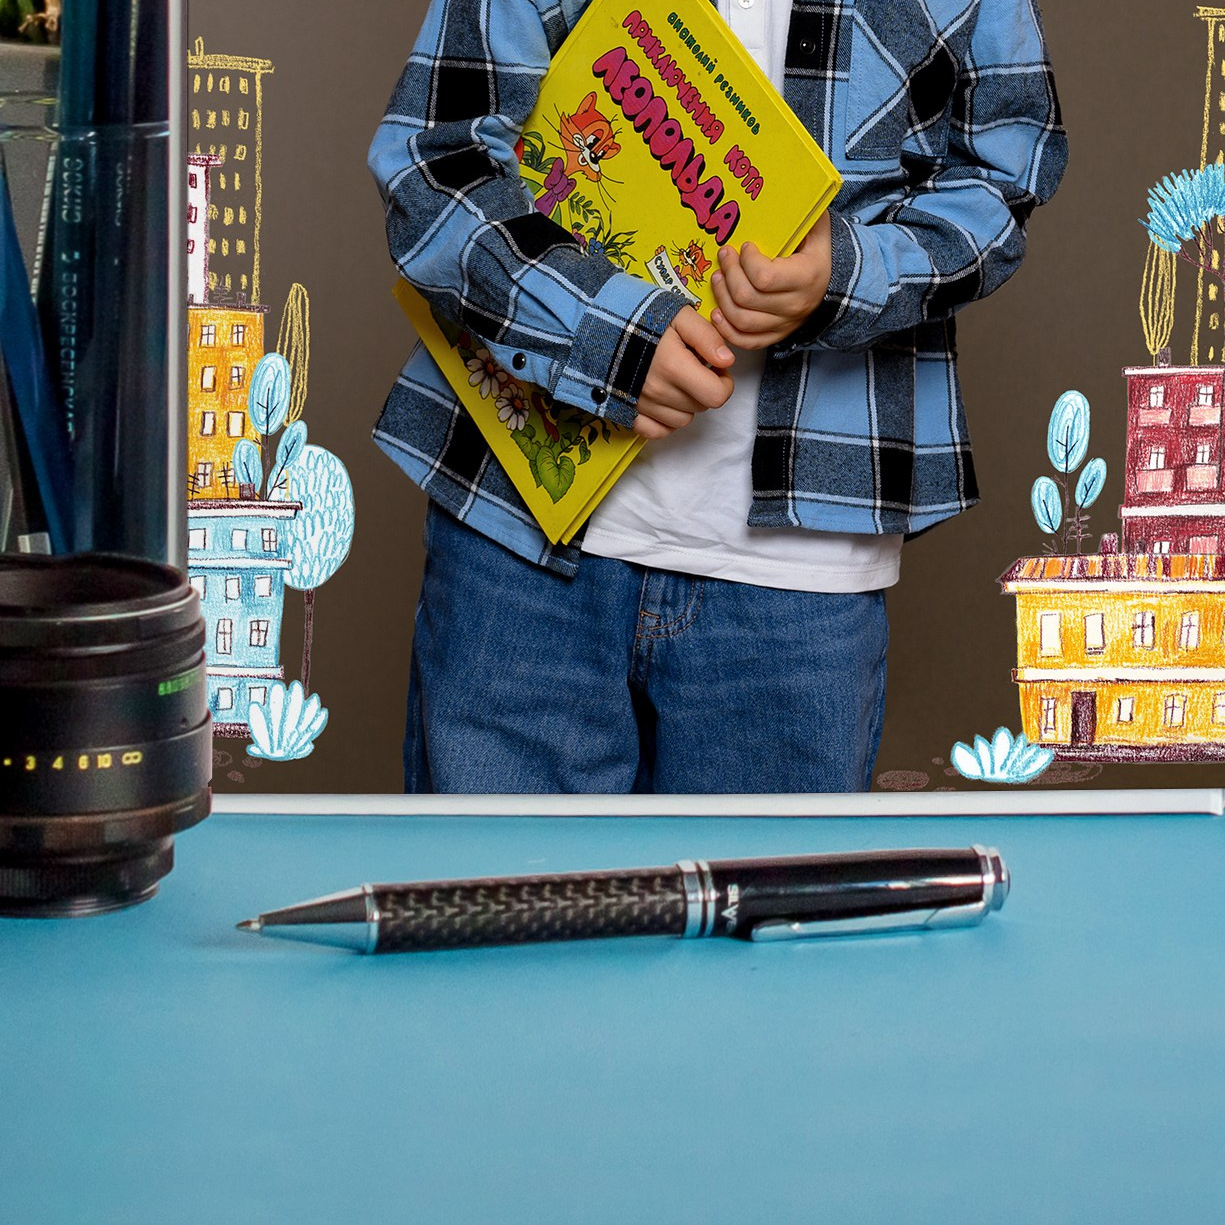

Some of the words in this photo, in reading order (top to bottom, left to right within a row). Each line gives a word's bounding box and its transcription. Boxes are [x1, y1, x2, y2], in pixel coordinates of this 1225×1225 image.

[592, 46, 741, 247] ЛЕОПОЛЬДА
[622, 10, 725, 144] ПРИКЛЮЧЕНИЯ
[723, 144, 764, 201] КОТА
[25, 756, 36, 771] 3
[52, 756, 63, 770] 4
[97, 754, 112, 769] 10
